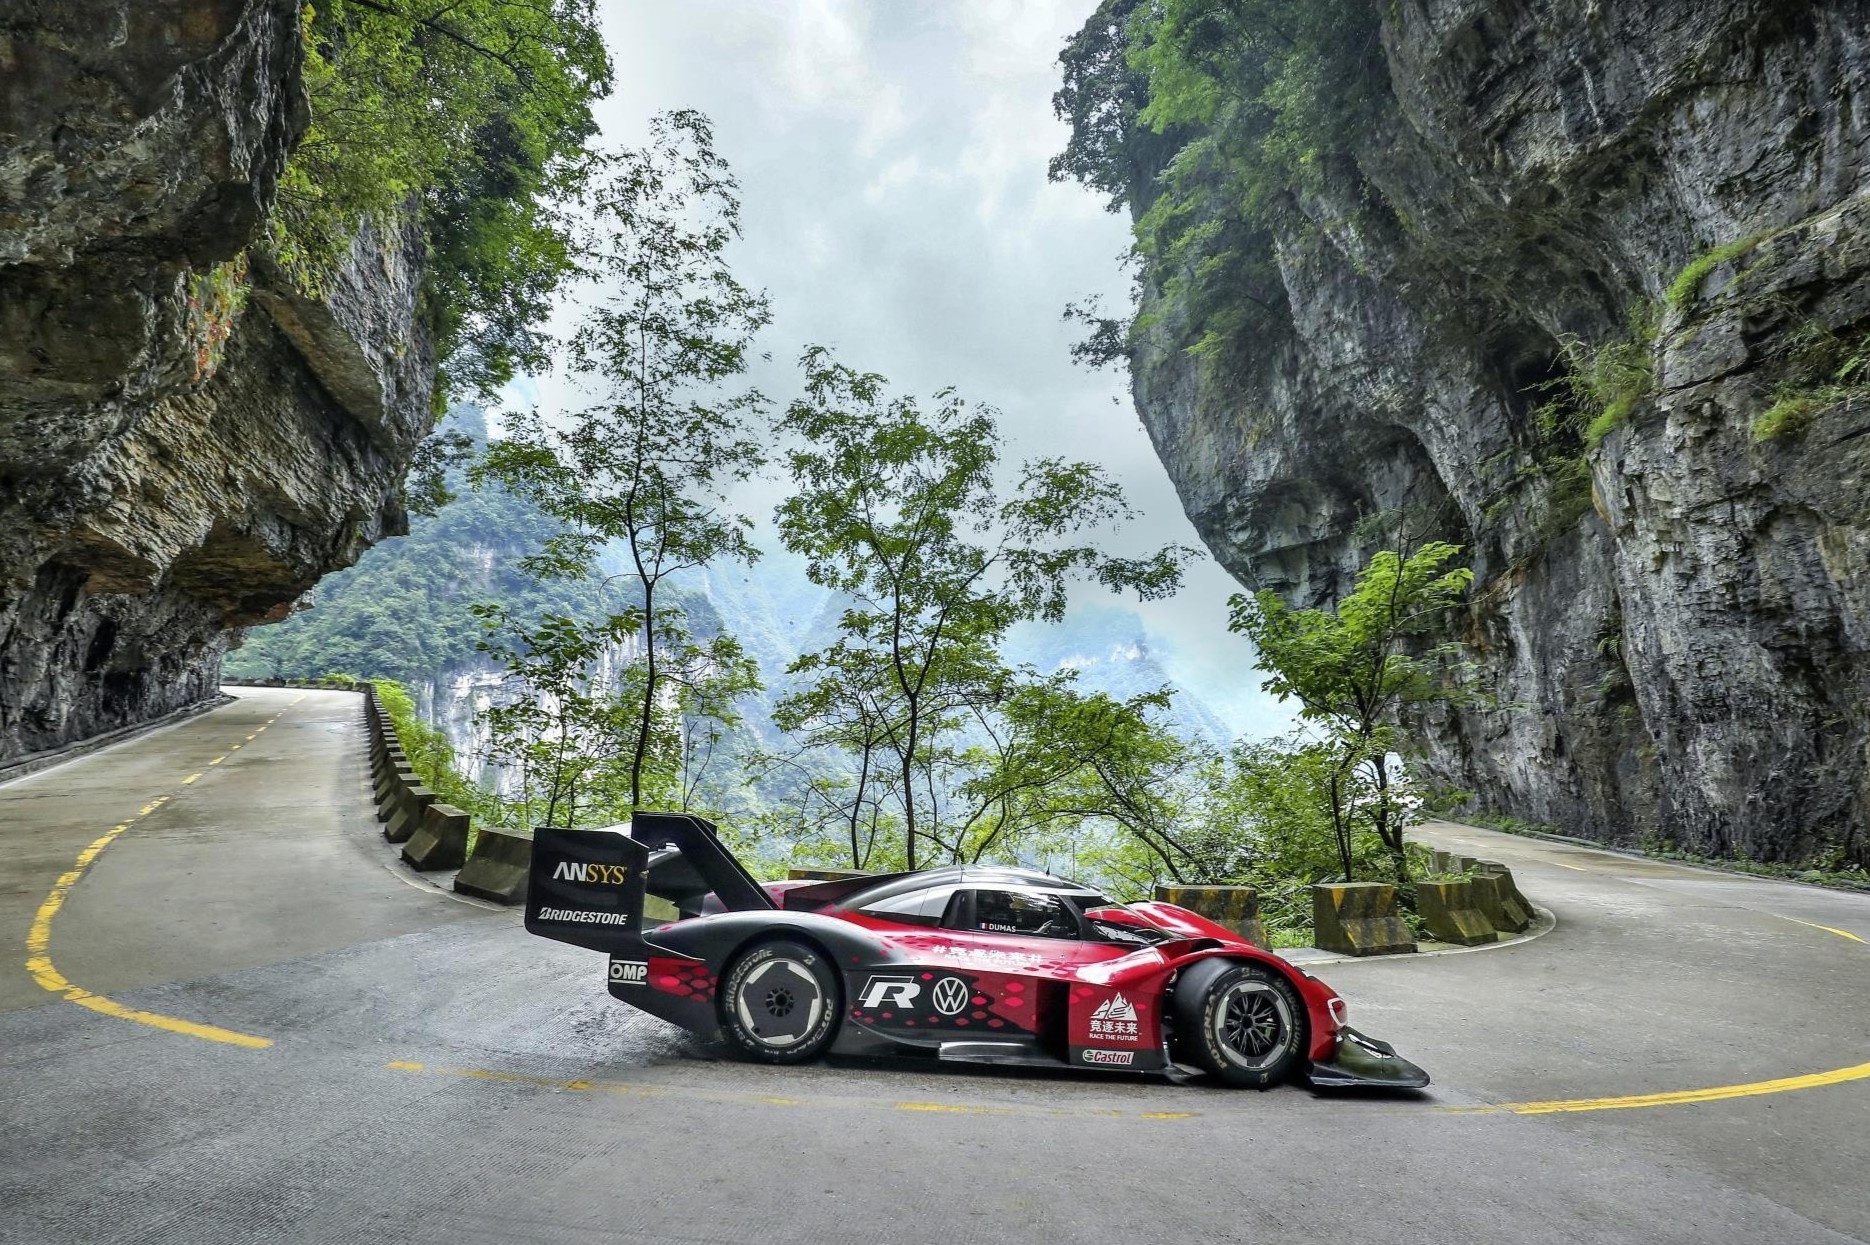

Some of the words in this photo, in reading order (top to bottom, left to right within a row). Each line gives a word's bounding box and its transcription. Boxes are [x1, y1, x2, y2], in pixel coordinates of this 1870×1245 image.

[552, 861, 625, 885] ANSYS
[538, 907, 628, 925] BRIDGESTONE
[988, 923, 1017, 933] DUMAS
[610, 963, 648, 980] OMP
[1089, 1019, 1138, 1035] 竞逐未来
[1116, 1034, 1138, 1042] FUTURE
[1094, 1051, 1132, 1064] Castrol
